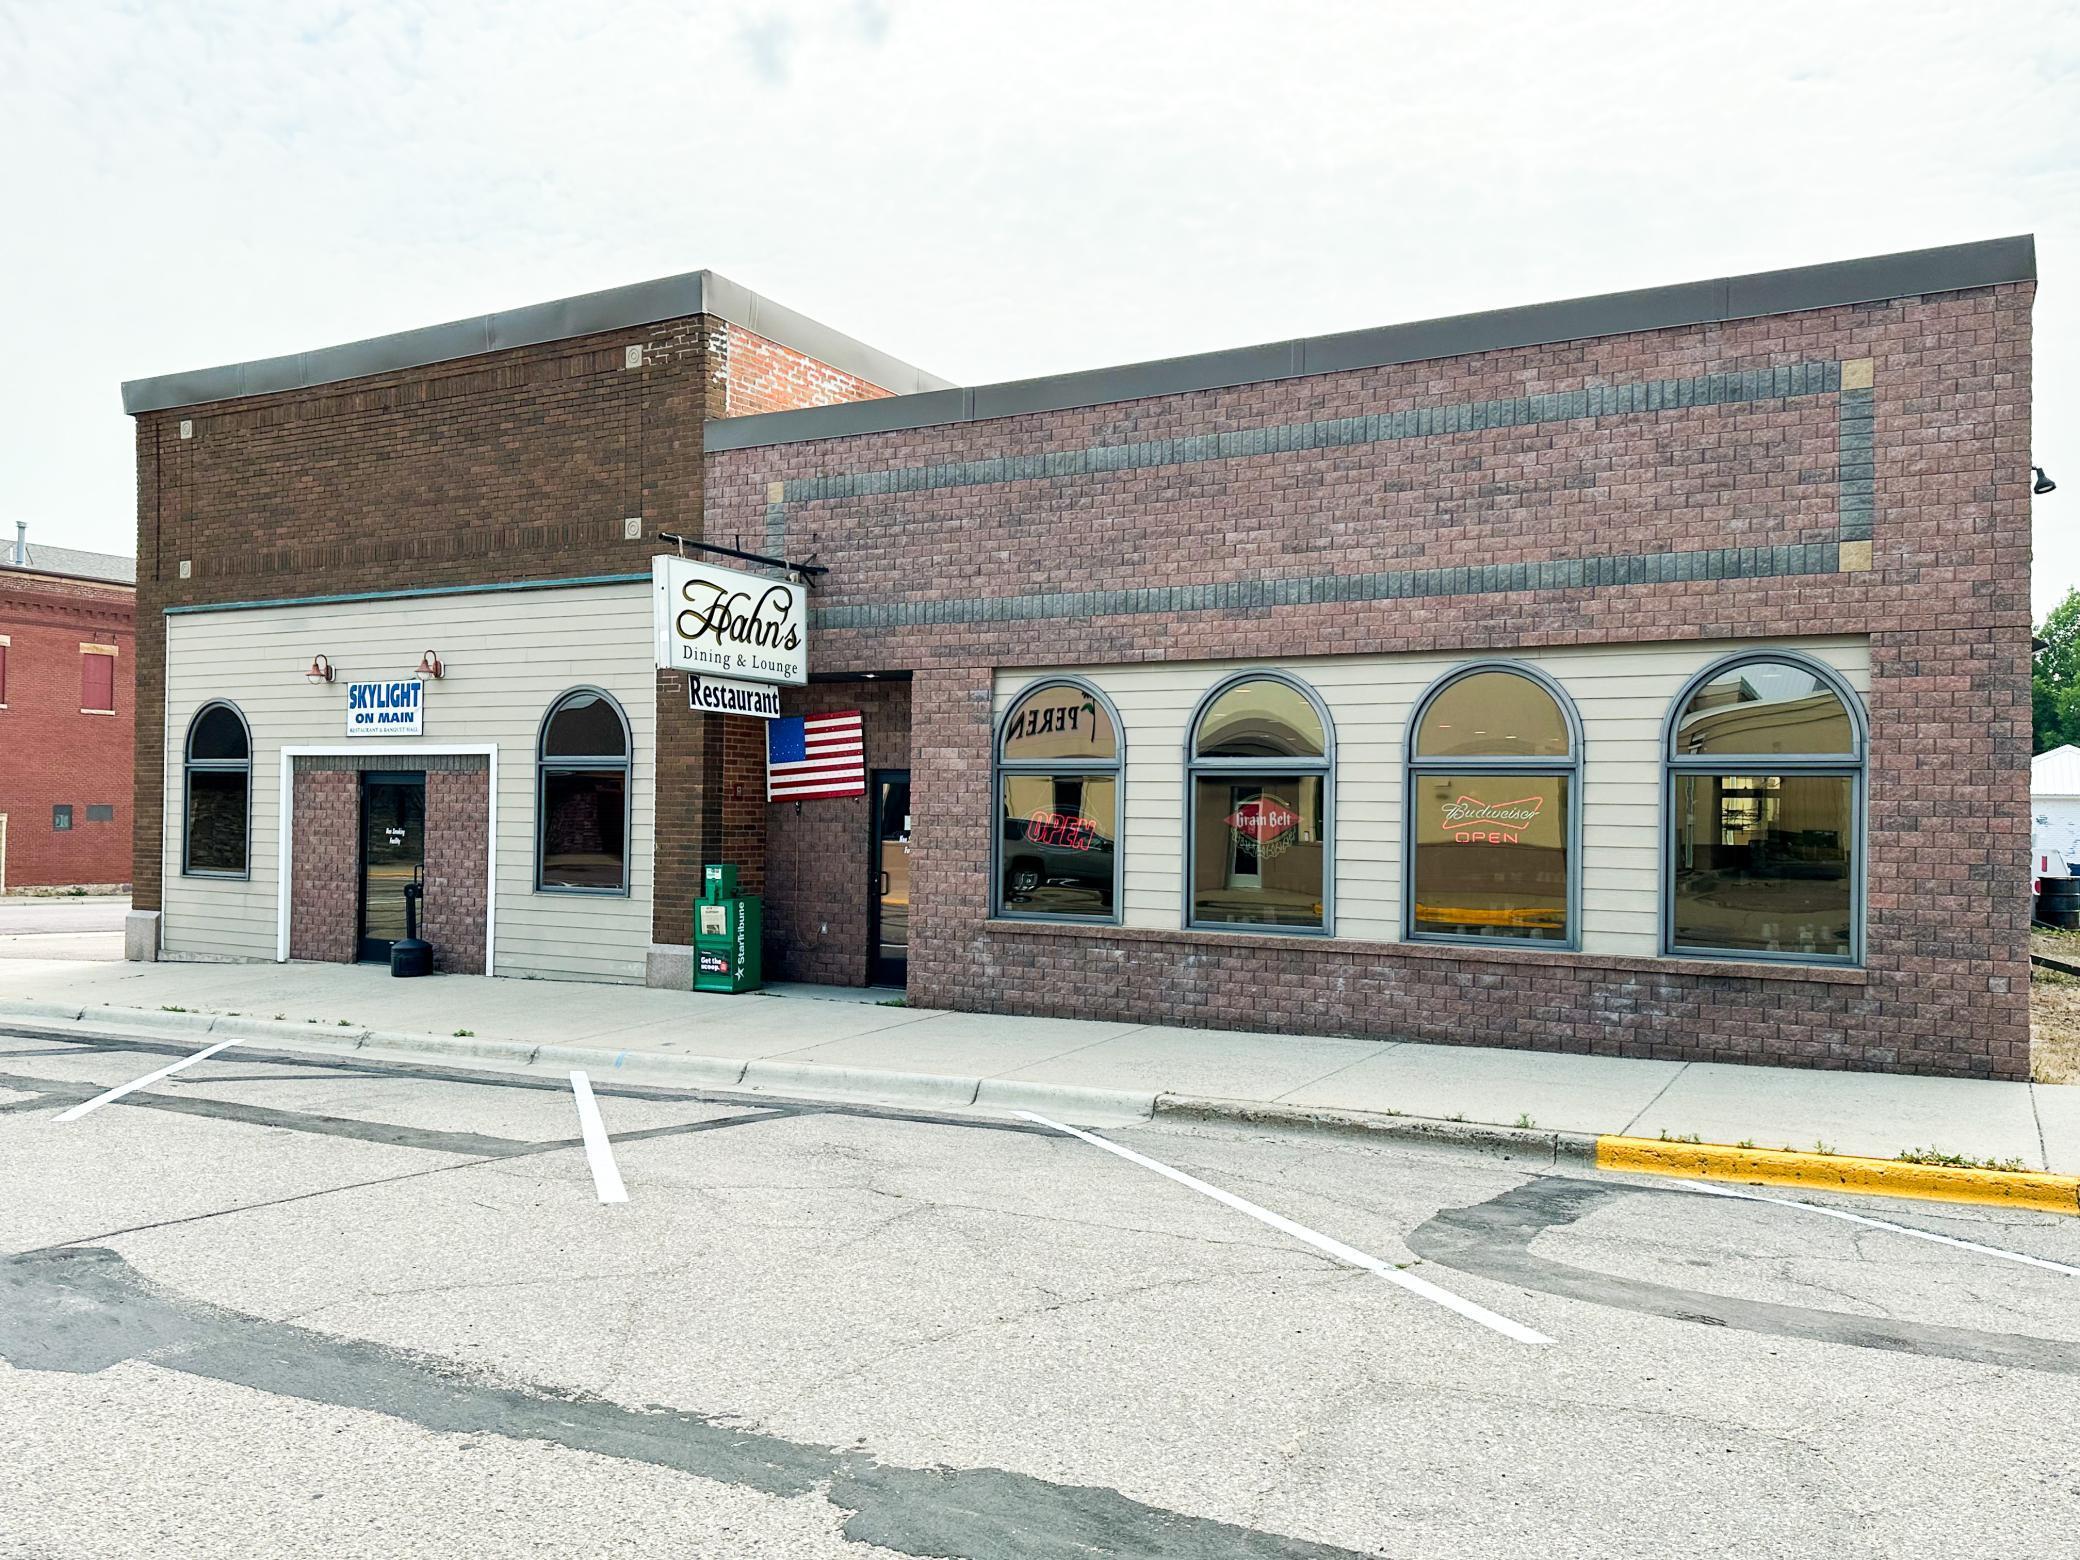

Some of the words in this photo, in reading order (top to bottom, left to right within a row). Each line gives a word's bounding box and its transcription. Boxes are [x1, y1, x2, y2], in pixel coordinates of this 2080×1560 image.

[676, 579, 801, 651] Hahn's
[683, 645, 731, 670] Dining
[737, 654, 747, 668] &
[752, 655, 798, 678] Lounge
[349, 683, 421, 709] SKYLIGHT
[689, 675, 779, 715] Restaurant
[355, 713, 374, 724] ON
[378, 712, 414, 723] MAIN
[1236, 811, 1267, 828] Grain
[1269, 811, 1291, 828] Belt
[1441, 803, 1540, 820] Budweiser
[1027, 811, 1096, 851] OPEN
[1455, 832, 1518, 844] OPEN
[737, 901, 745, 965] StarTribune
[700, 956, 711, 965] Get
[711, 957, 722, 965] the
